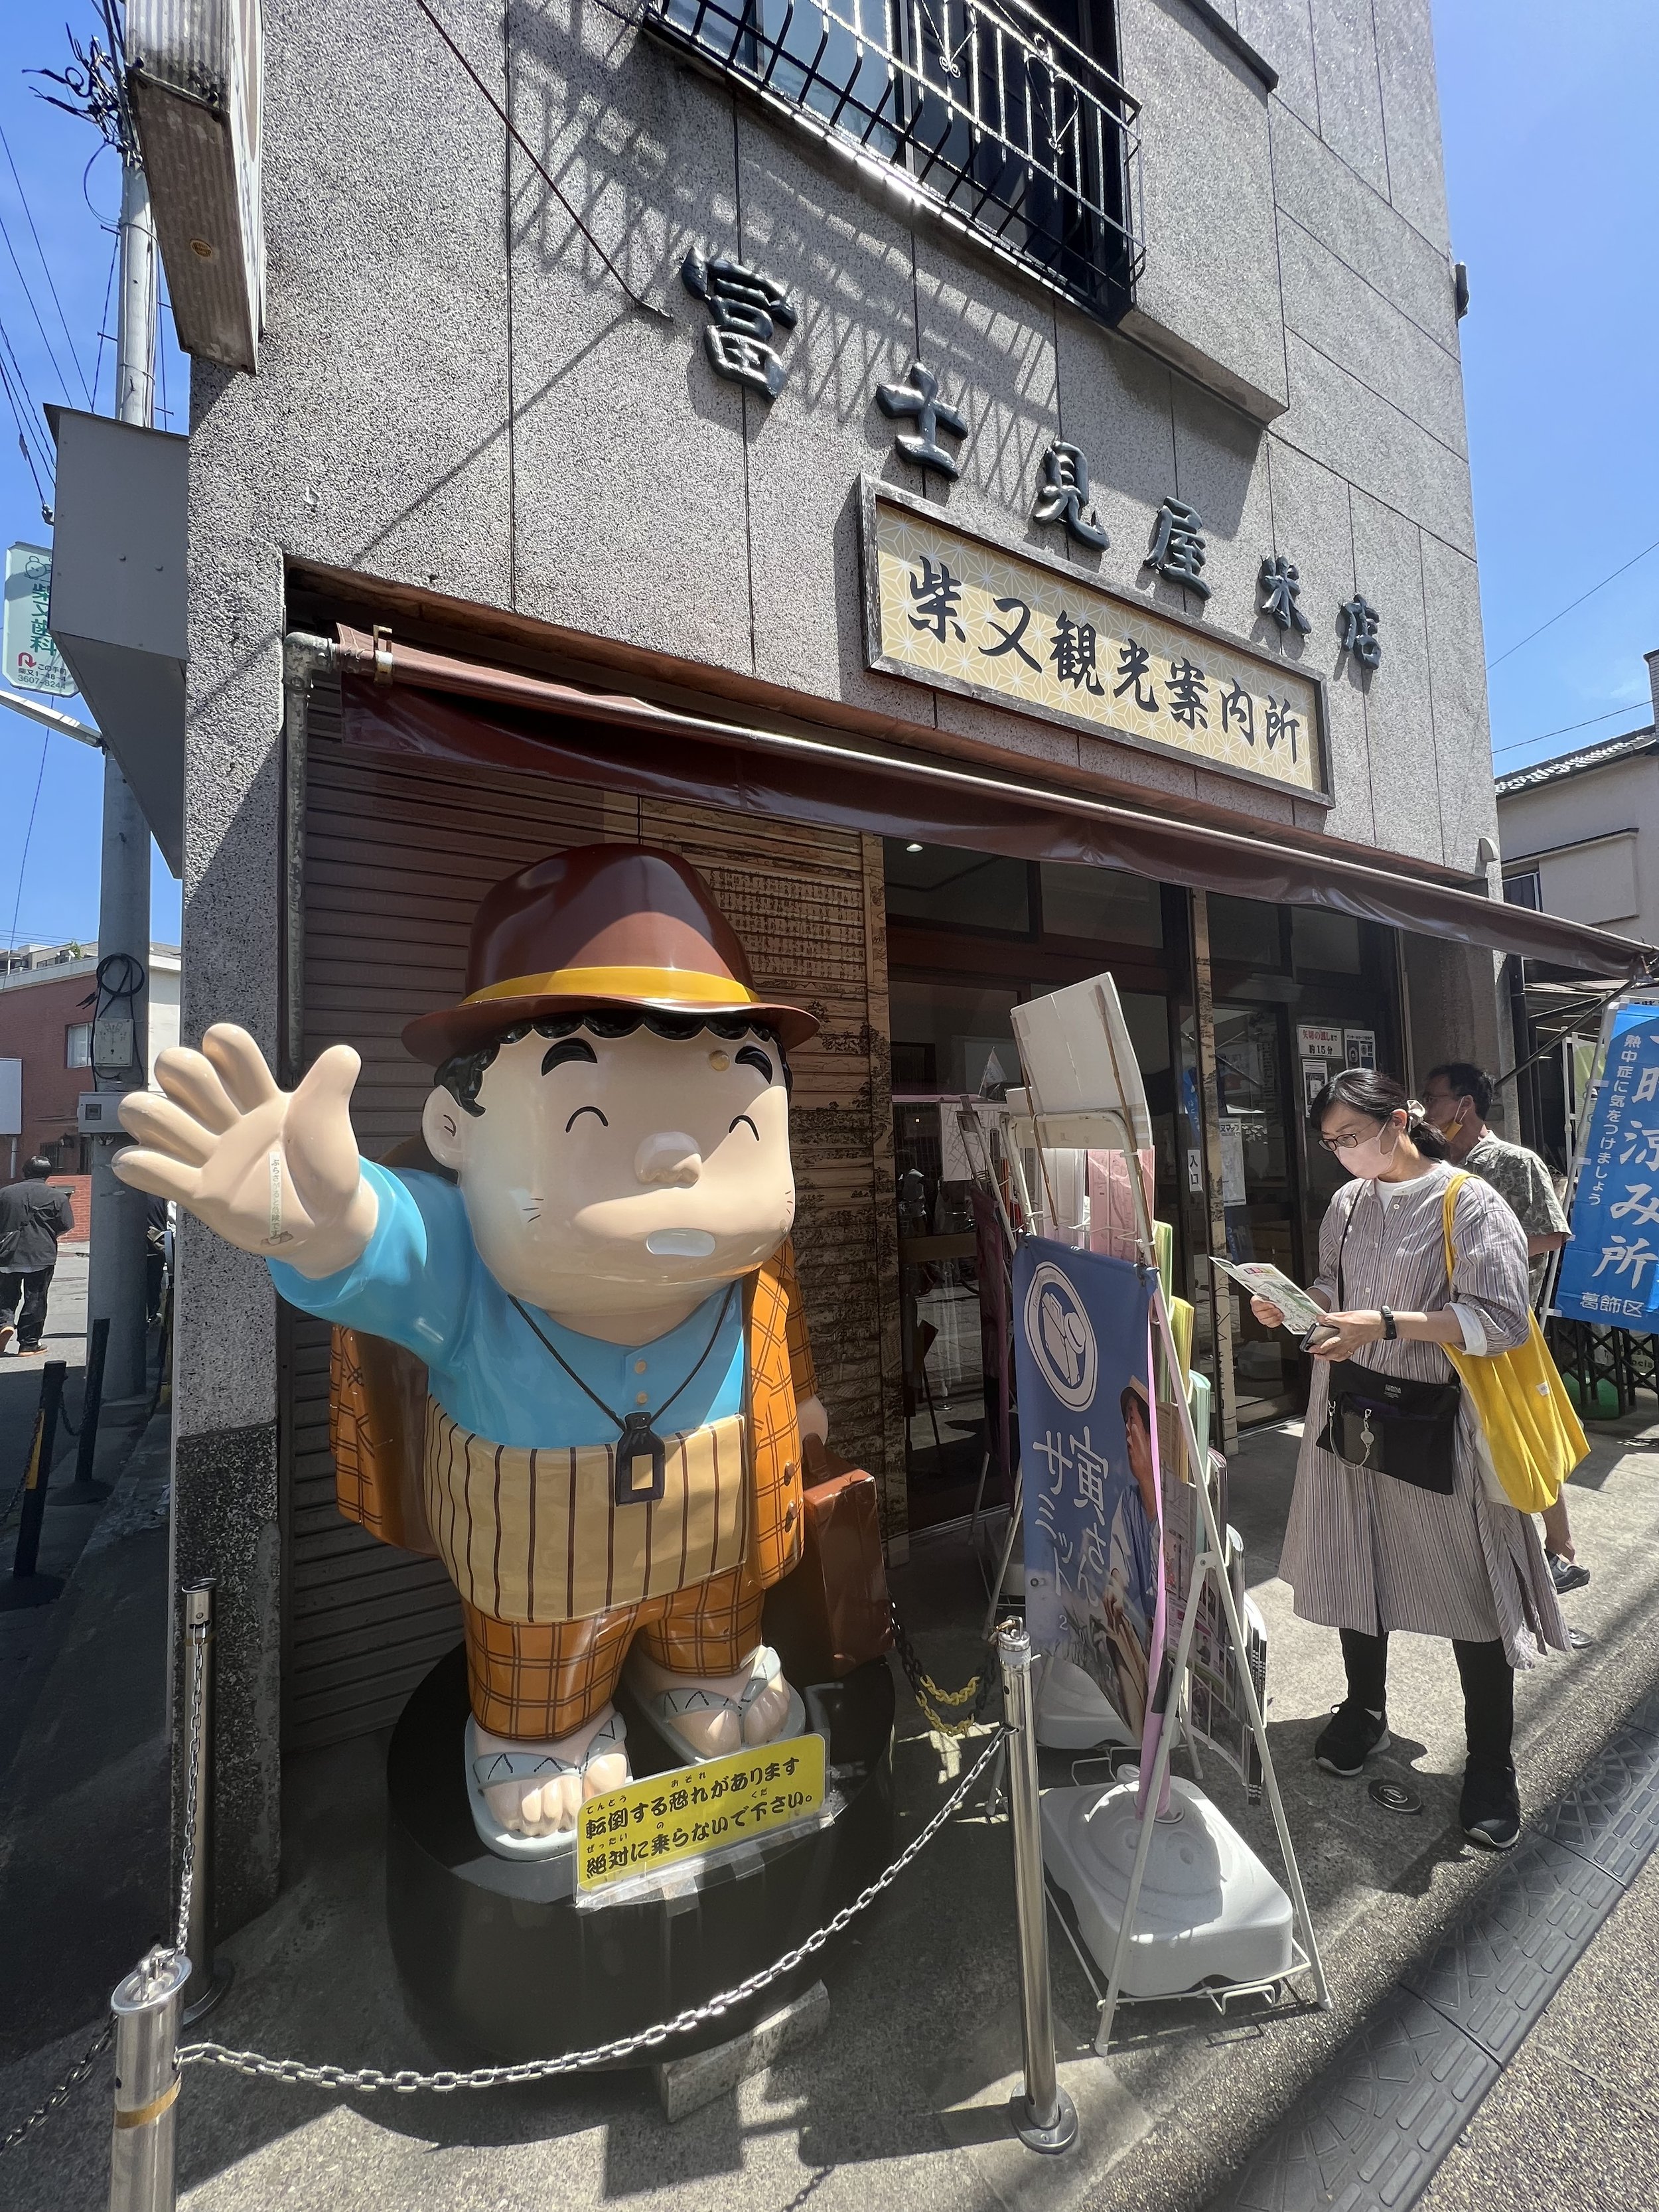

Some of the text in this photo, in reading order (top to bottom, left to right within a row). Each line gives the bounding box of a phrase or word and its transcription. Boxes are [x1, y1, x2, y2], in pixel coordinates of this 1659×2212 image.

[908, 555, 1300, 765] 柴又観光案内所
[1587, 1034, 1642, 1207] 熱中症に気をつけましょう
[1189, 1154, 1198, 1185] 入口
[1579, 1291, 1645, 1318] 葛飾区
[1033, 1430, 1074, 1596] サミット
[1069, 1426, 1109, 1607] 寅さん
[670, 1771, 707, 1788] おそれ
[751, 1787, 768, 1799] くだ
[586, 1757, 800, 1840] 転倒する恐れがあります
[586, 1794, 627, 1814] てんとう
[587, 1791, 813, 1878] 絶対に乗らないで下さい。
[656, 1820, 664, 1830] の
[586, 1832, 628, 1853] ぜったい
